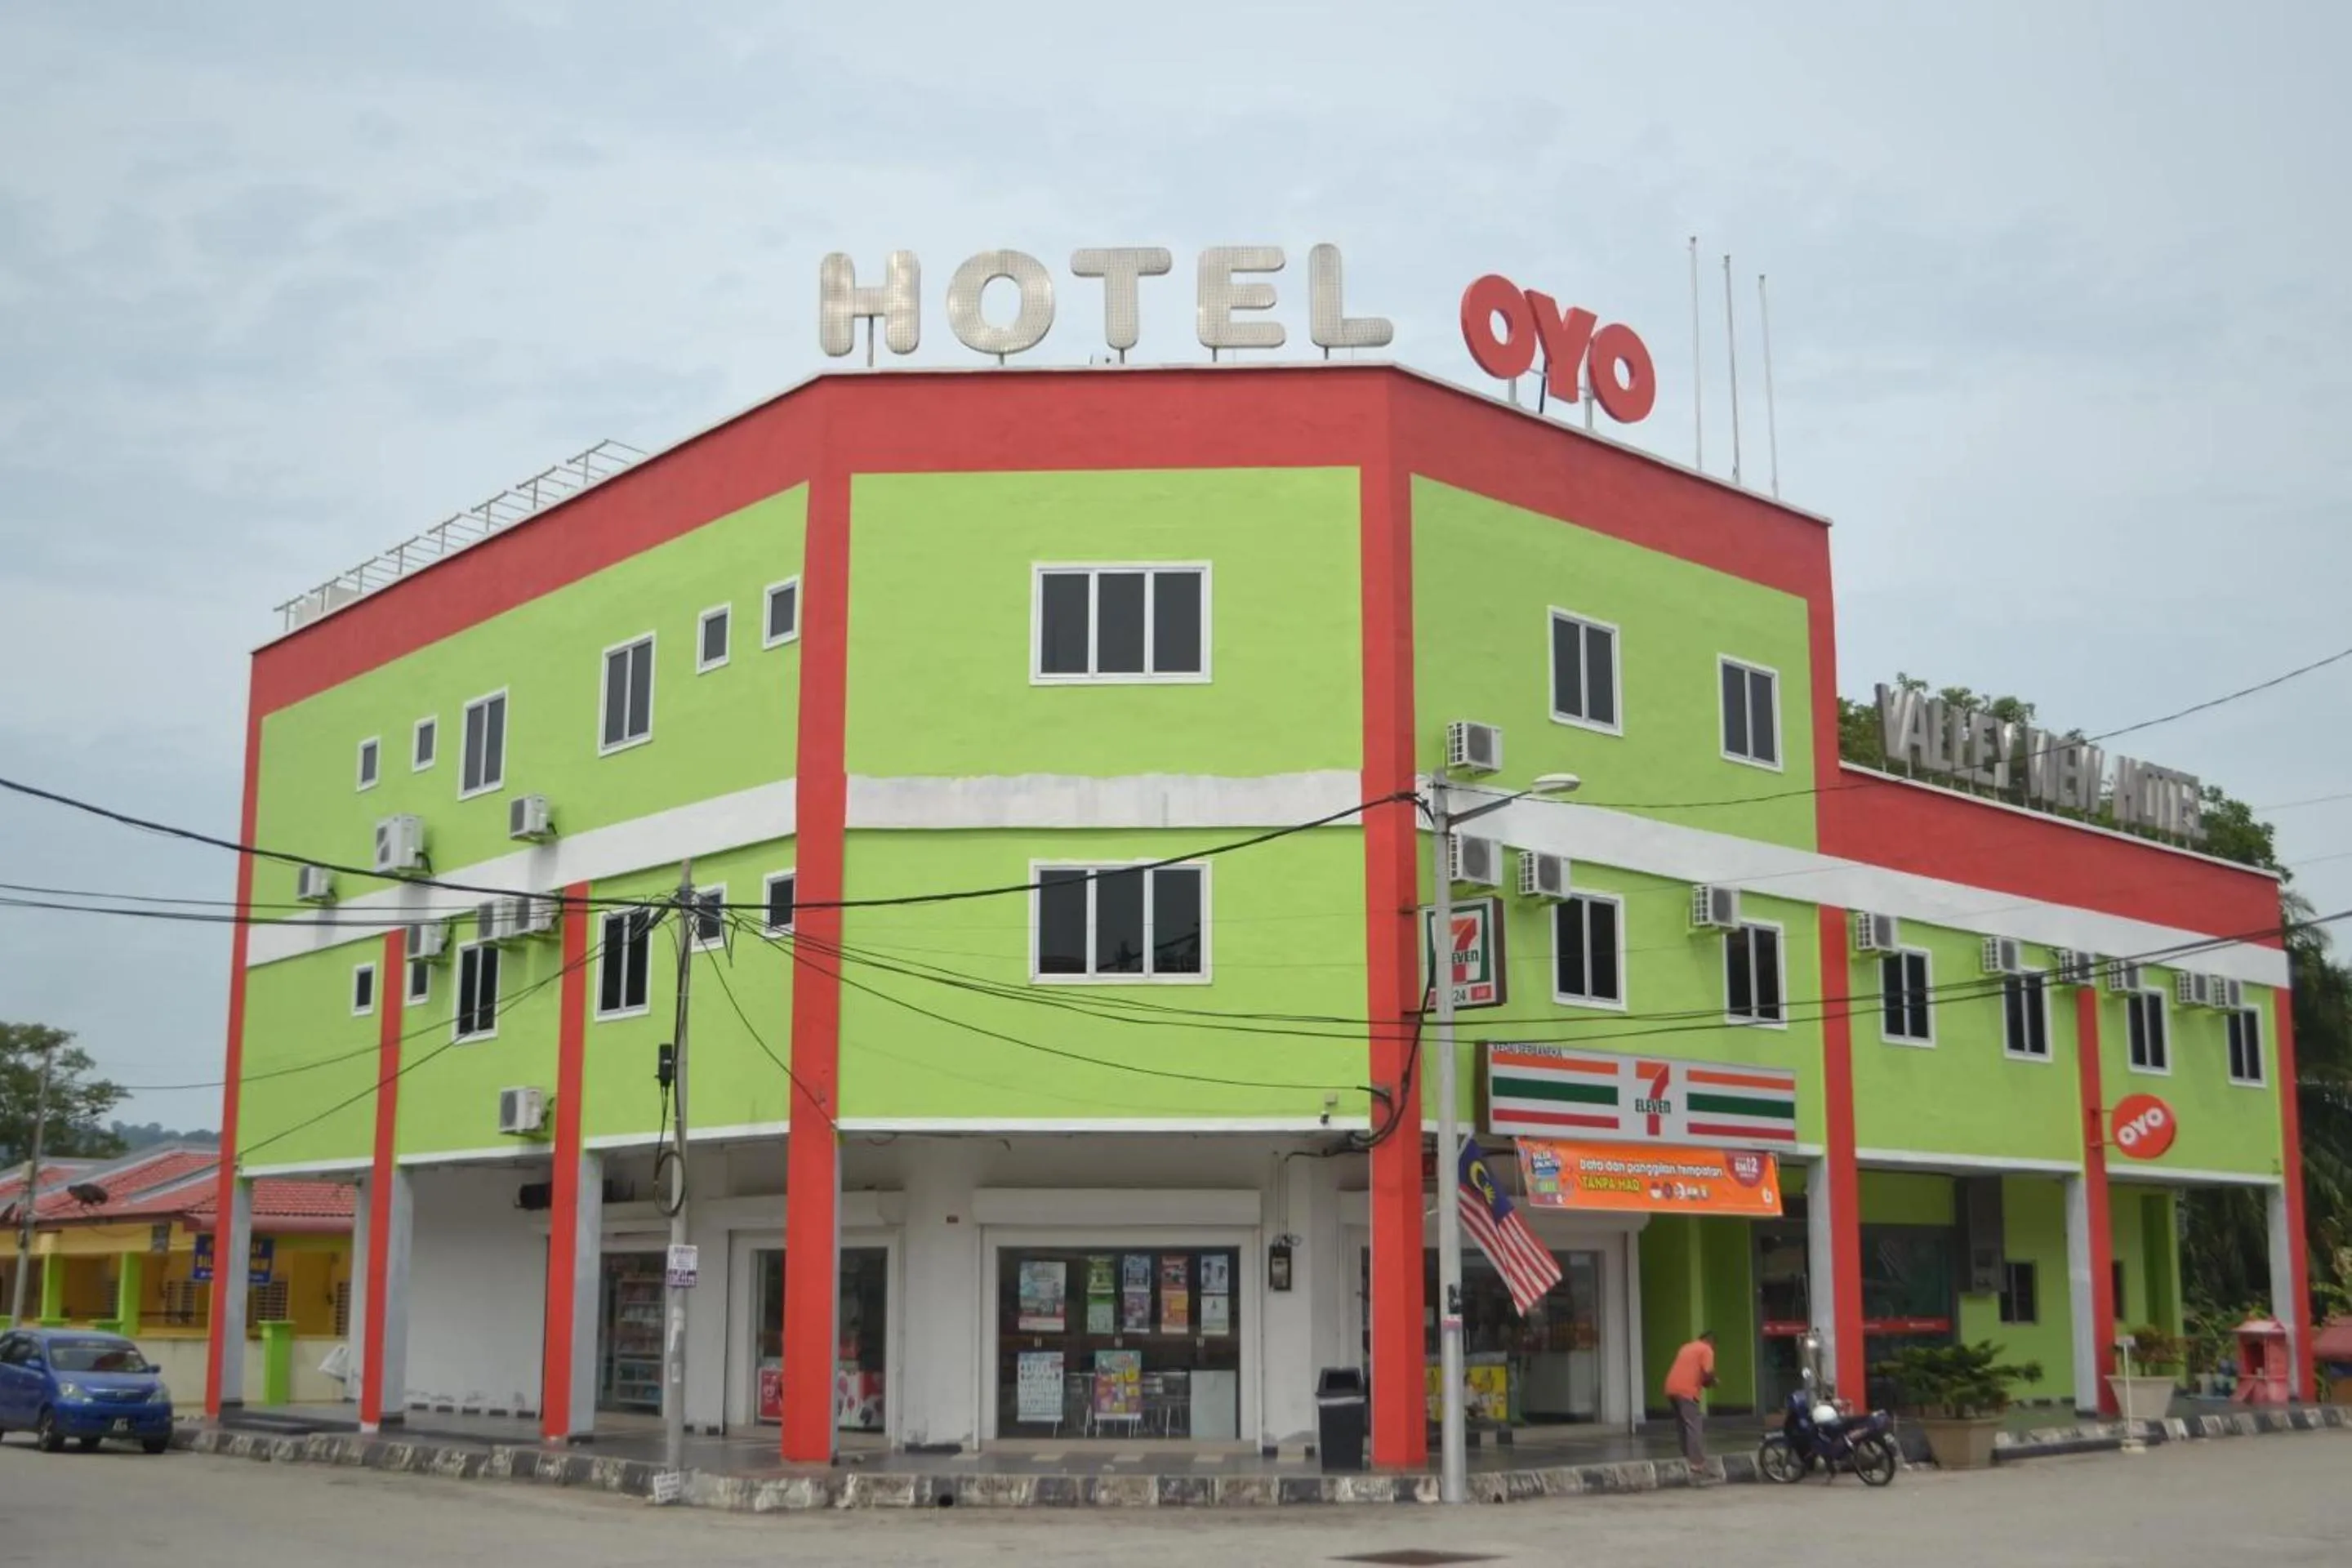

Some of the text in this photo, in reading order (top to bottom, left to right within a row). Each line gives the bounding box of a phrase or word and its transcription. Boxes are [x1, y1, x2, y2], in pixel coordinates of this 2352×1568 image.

[819, 243, 1394, 358] HOTEL
[1459, 273, 1656, 424] OYO
[1875, 683, 2015, 789] VALLEY
[1451, 917, 1477, 982] 7
[1635, 1061, 1669, 1136] 7
[2118, 1107, 2164, 1146] OYO
